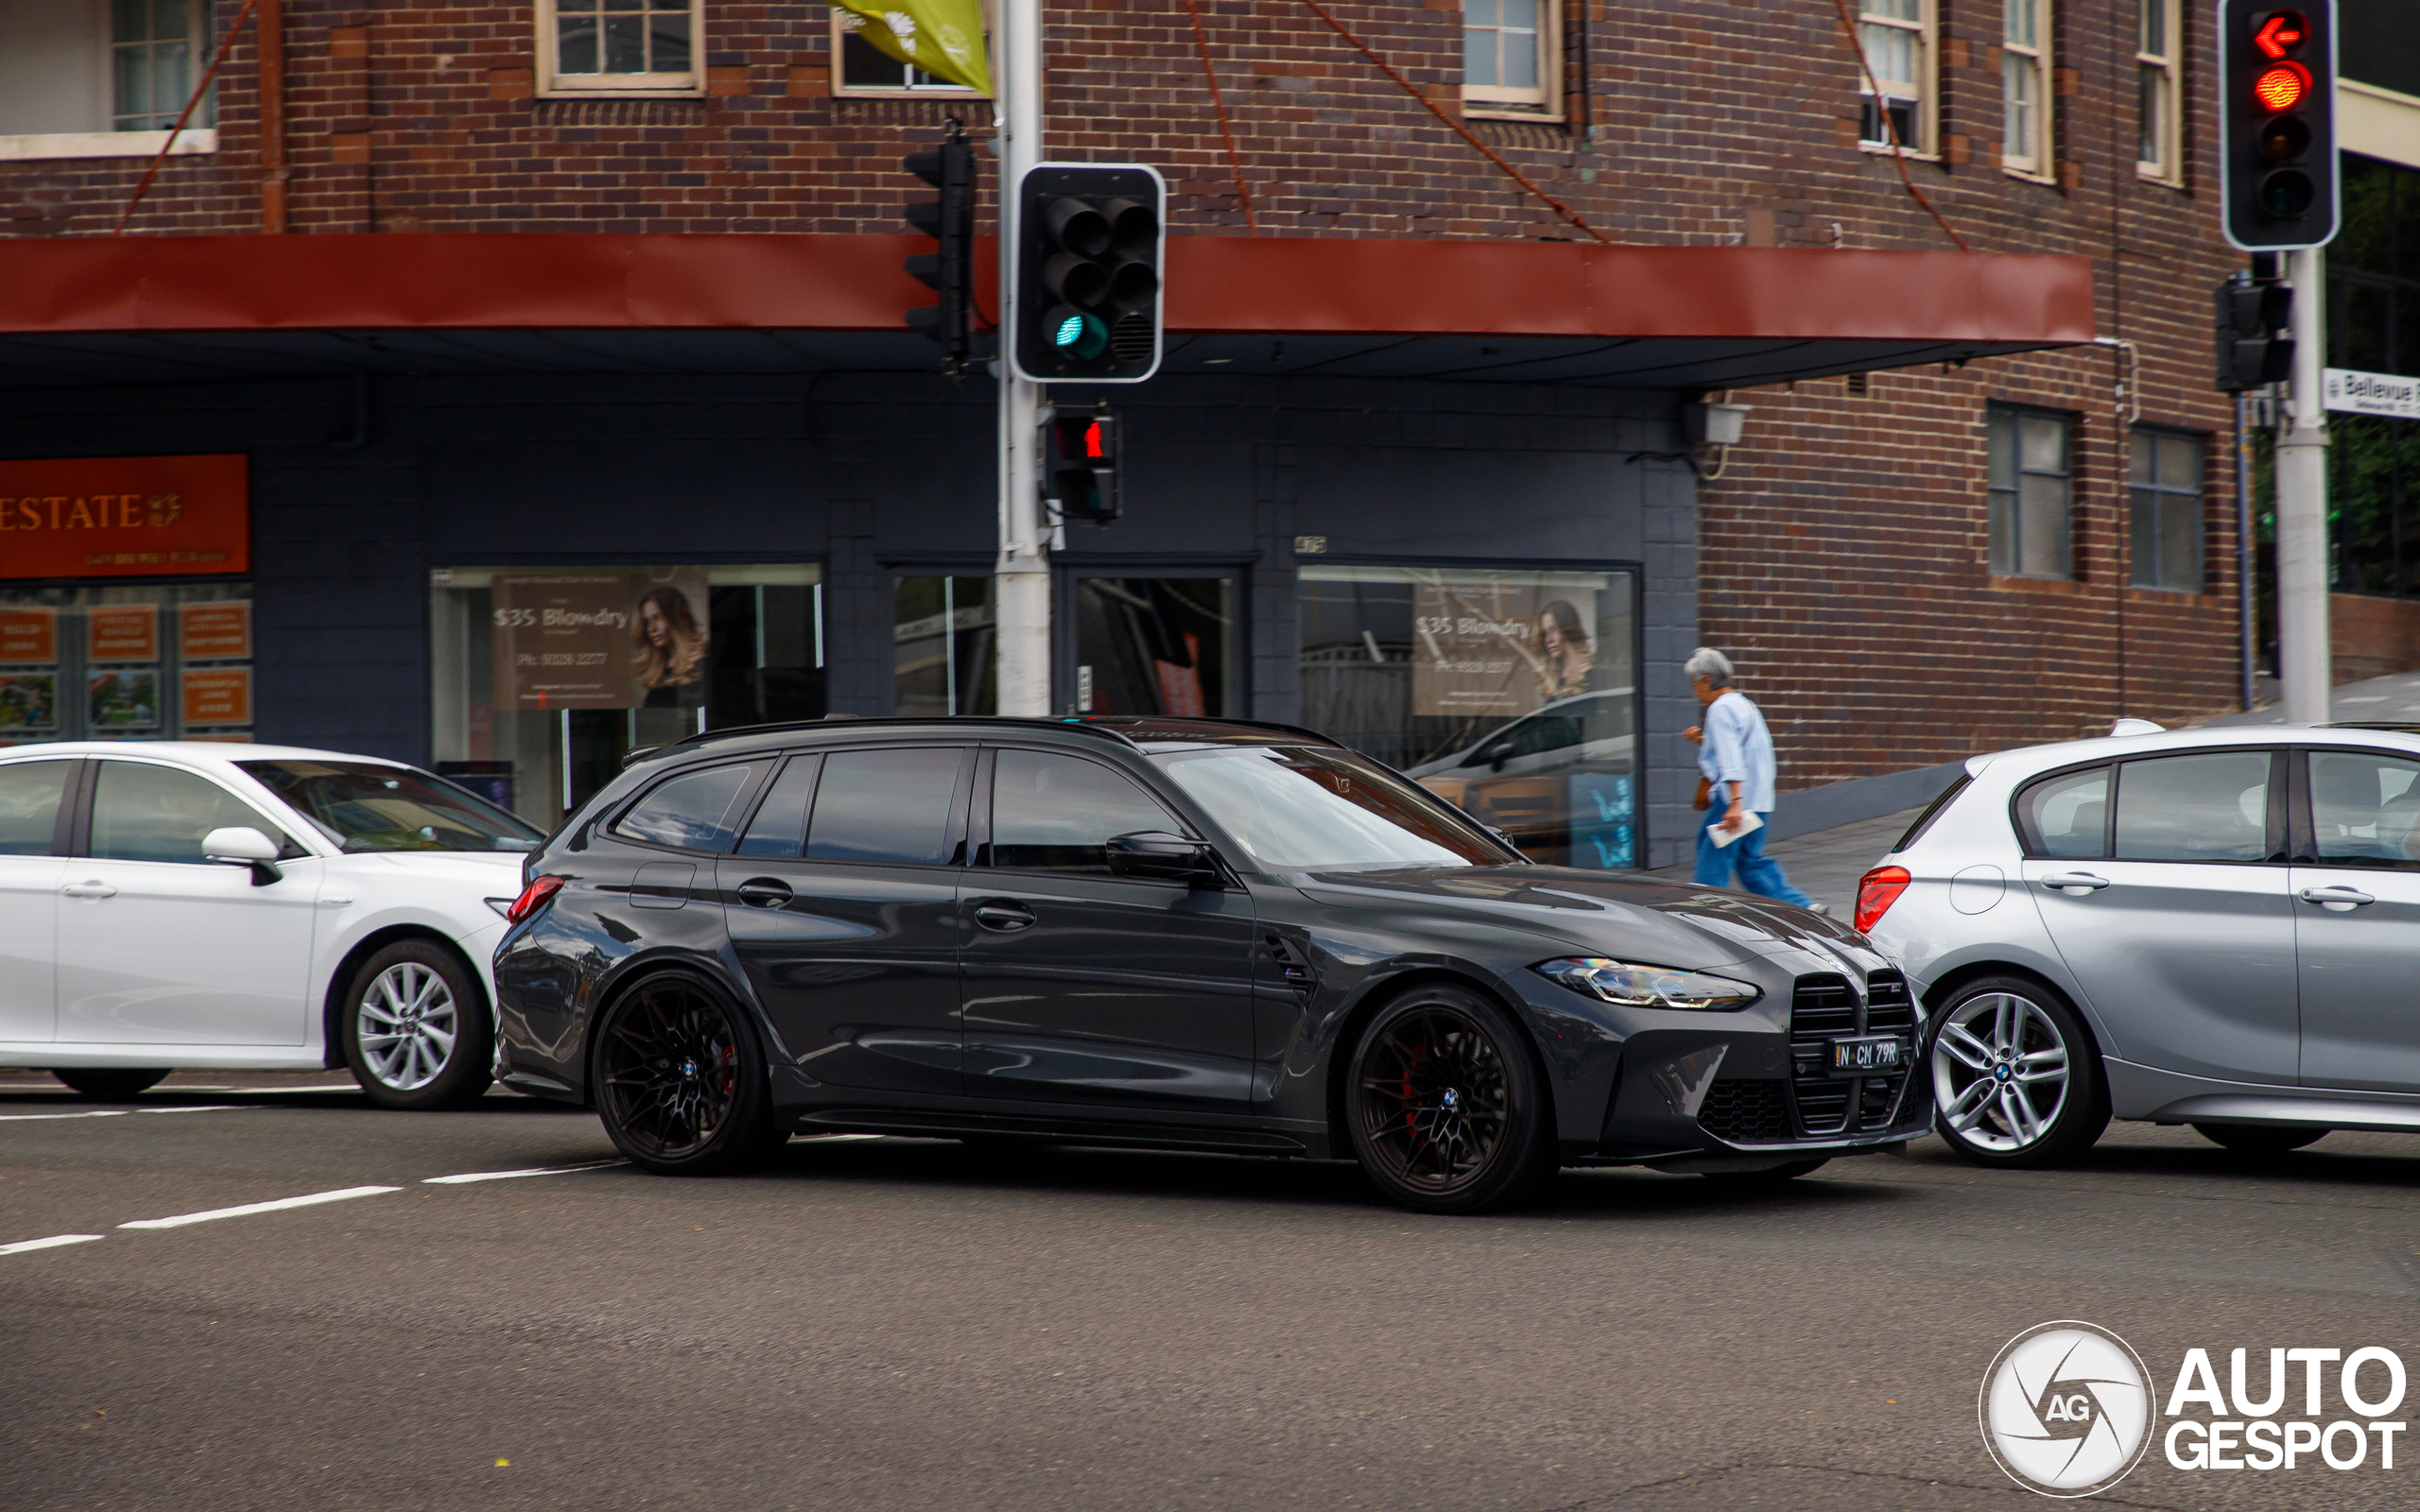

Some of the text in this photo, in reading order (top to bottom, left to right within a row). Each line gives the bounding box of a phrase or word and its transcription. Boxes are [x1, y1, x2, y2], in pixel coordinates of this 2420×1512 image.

[2344, 374, 2413, 402] Bellevue
[0, 493, 143, 531] ESTATE
[494, 608, 537, 627] $35
